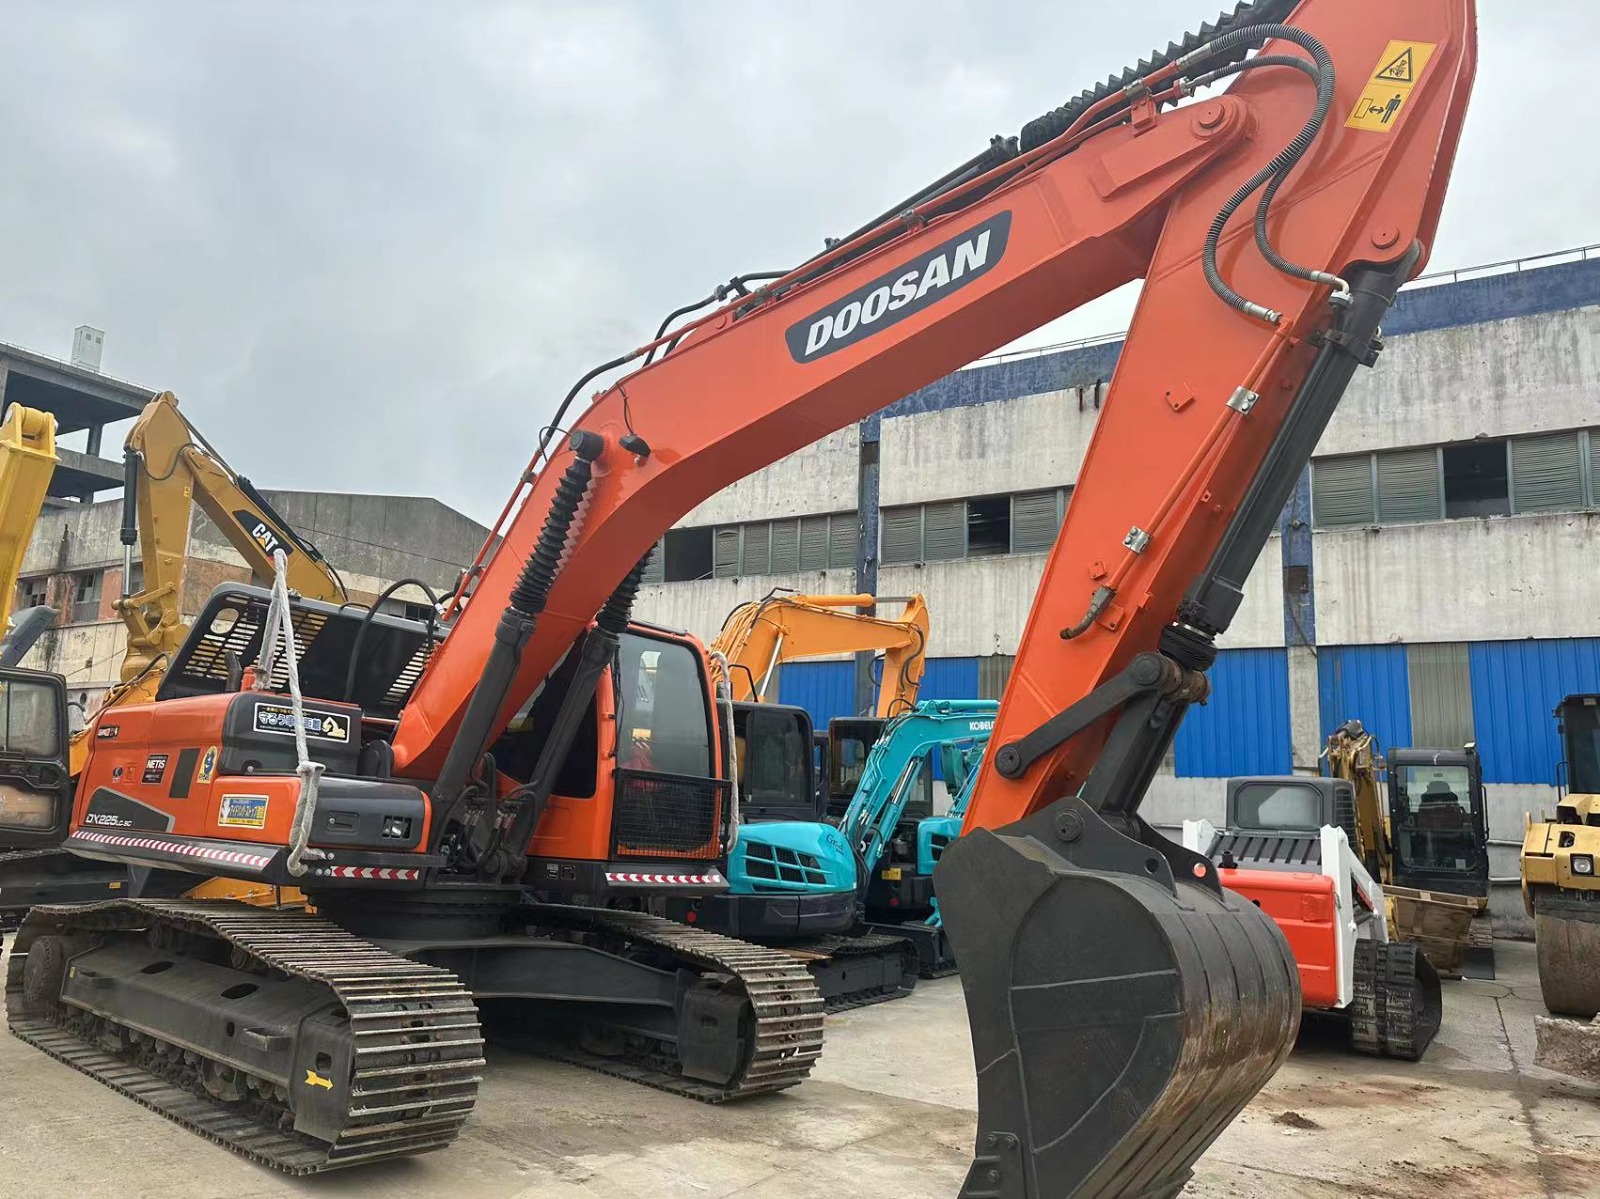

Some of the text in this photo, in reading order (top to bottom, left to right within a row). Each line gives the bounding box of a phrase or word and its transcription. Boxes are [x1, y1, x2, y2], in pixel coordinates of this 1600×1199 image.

[804, 229, 991, 357] DOOSAN
[252, 522, 279, 552] CAT
[969, 720, 996, 731] KOBELC
[145, 759, 166, 770] NETIS
